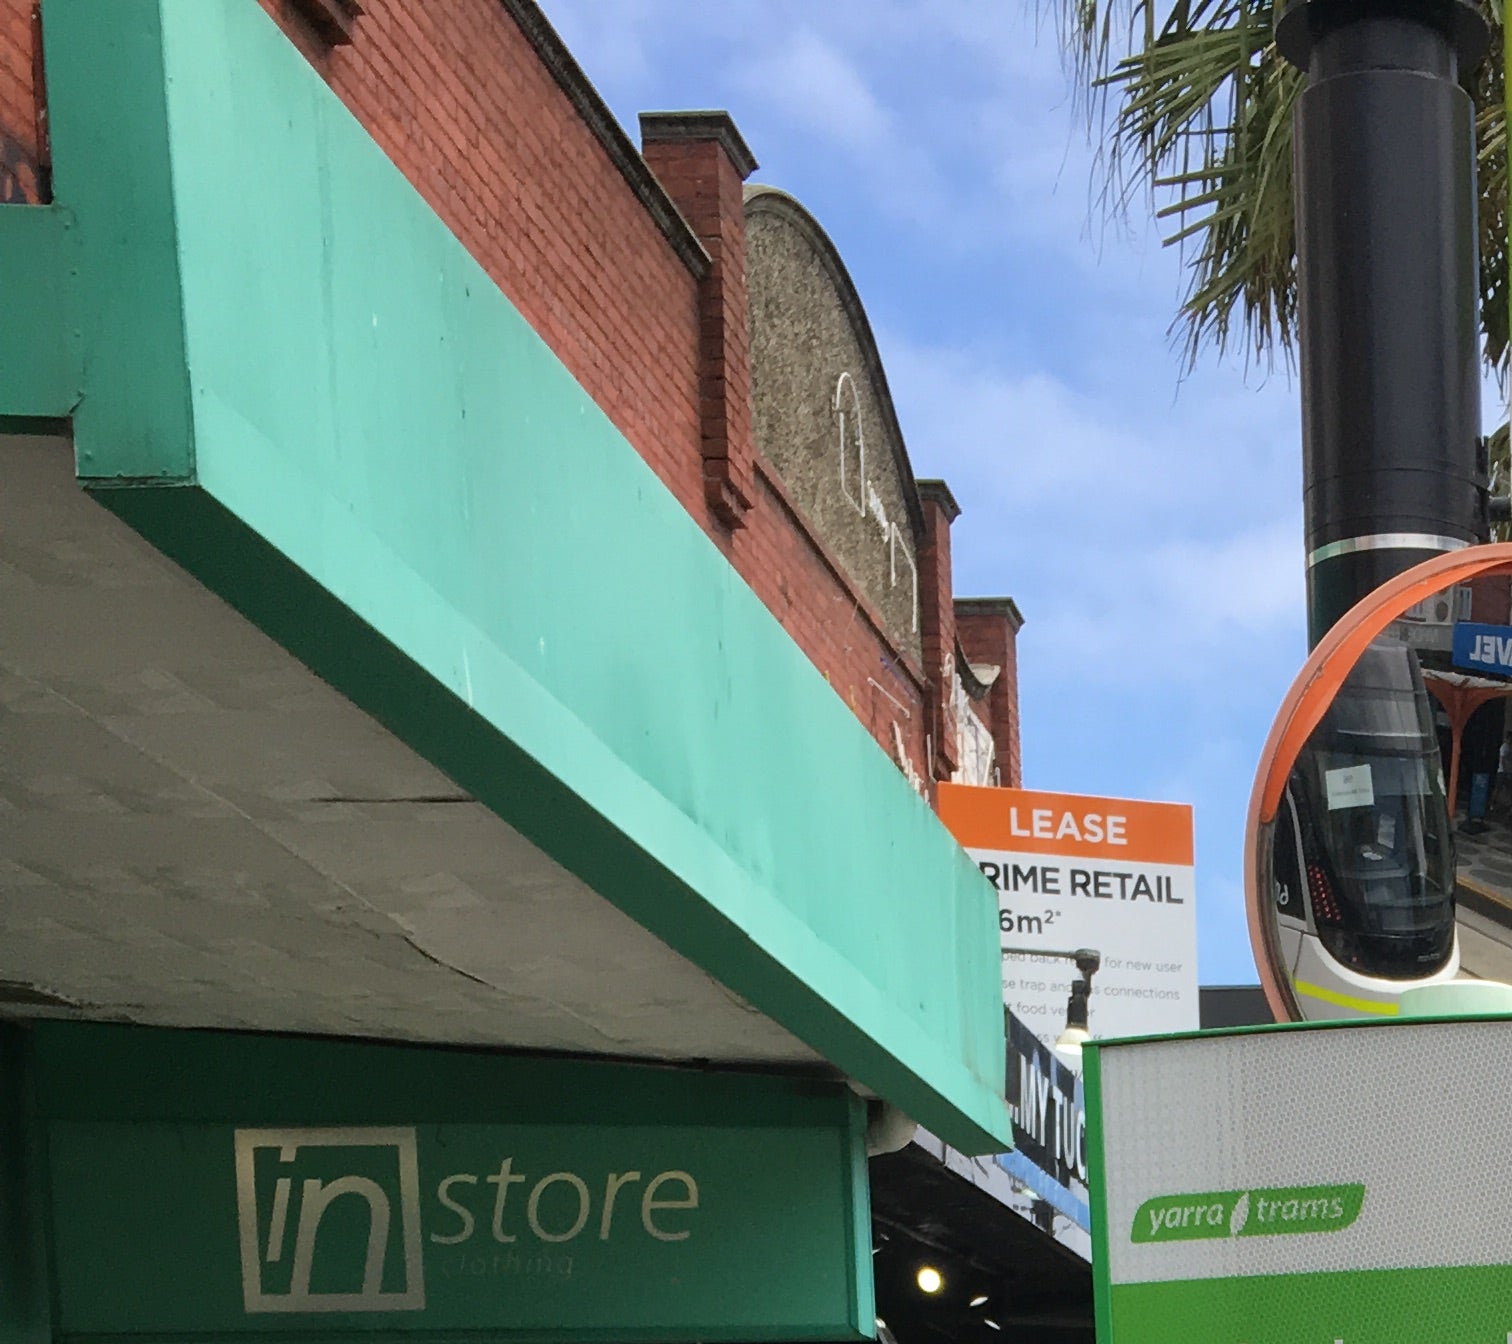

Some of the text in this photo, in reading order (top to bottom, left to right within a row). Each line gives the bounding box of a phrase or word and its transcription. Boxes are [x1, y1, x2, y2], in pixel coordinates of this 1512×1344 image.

[1010, 807, 1128, 845] LEASE
[1070, 869, 1184, 904] RETAIL
[1105, 956, 1121, 969] for
[1126, 960, 1151, 971] new
[1156, 962, 1182, 973] user
[1020, 979, 1046, 992] trap
[1103, 984, 1181, 1000] connections
[1016, 1002, 1047, 1015] food
[266, 1145, 700, 1296] in store
[1149, 1195, 1344, 1235] yarra trams
